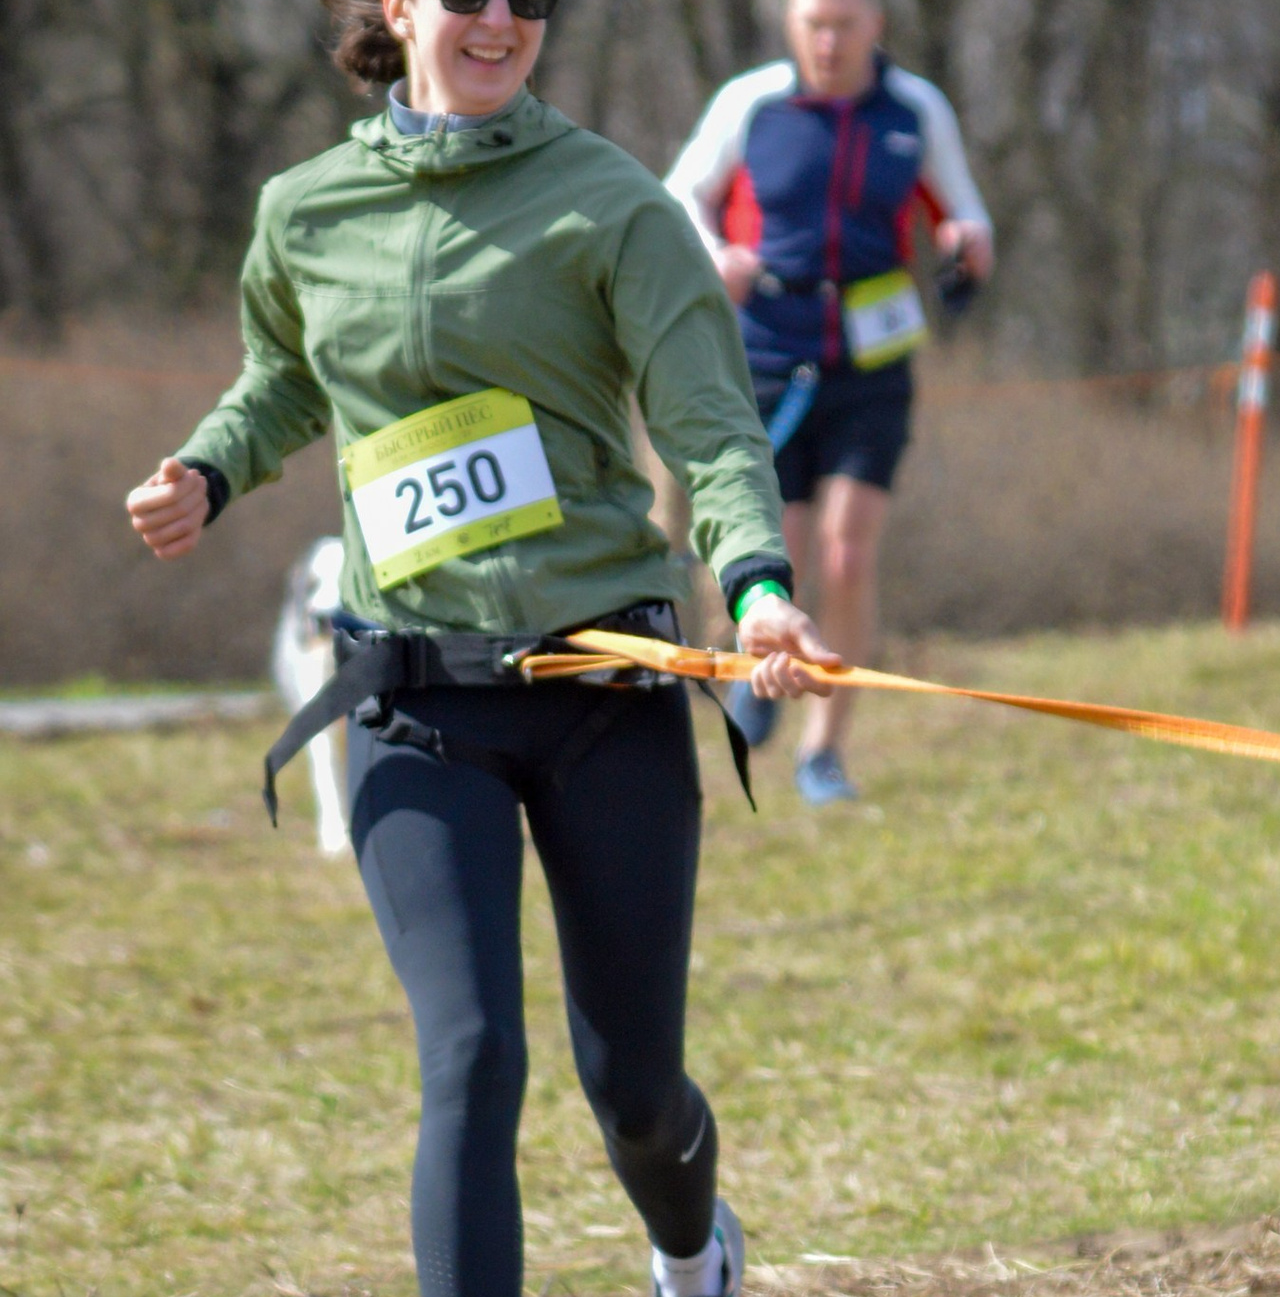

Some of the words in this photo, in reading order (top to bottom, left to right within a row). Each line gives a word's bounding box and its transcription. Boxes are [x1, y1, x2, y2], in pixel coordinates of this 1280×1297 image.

[374, 415, 453, 461] БЫСТРЫЙ
[455, 405, 493, 428] ПЁС
[396, 449, 506, 535] 250
[413, 549, 423, 563] 2
